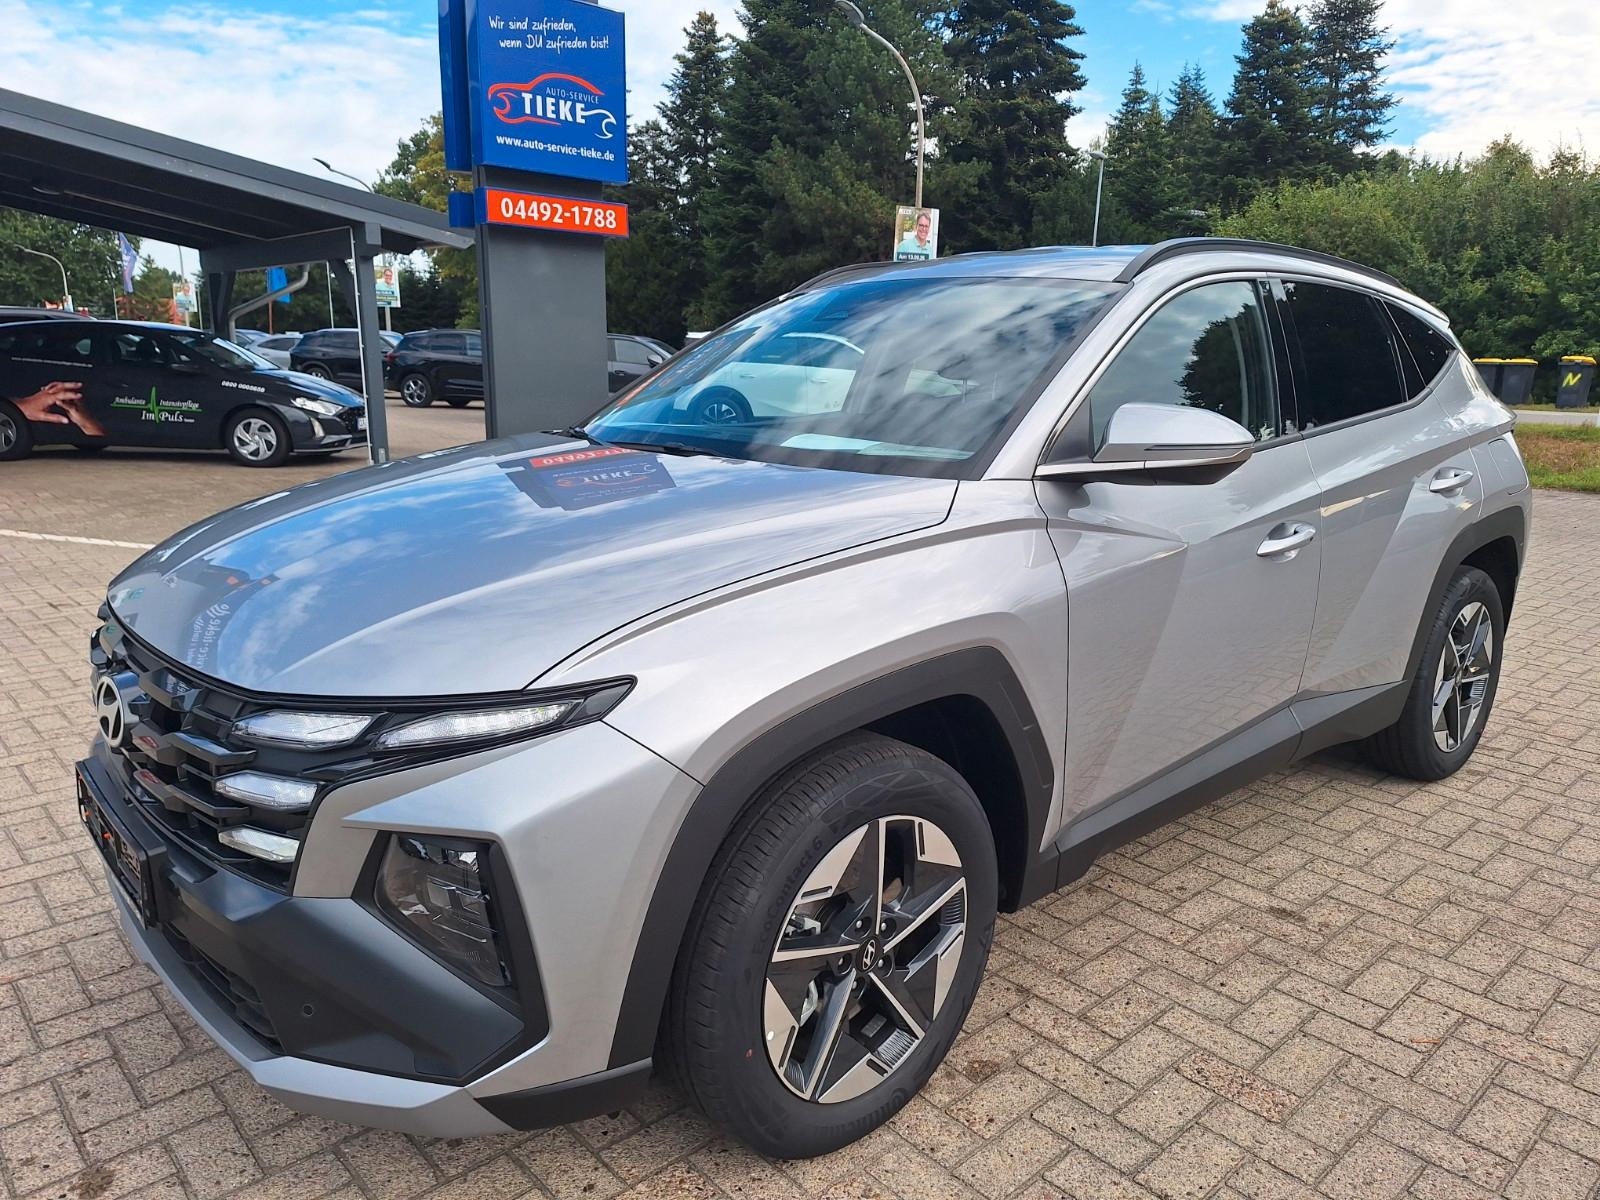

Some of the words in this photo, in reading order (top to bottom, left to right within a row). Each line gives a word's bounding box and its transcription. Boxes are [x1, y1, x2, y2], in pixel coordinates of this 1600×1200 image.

[488, 16, 505, 30] Wir
[508, 17, 528, 31] sind
[532, 19, 576, 36] zufrieden,
[499, 39, 522, 49] wenn
[526, 34, 543, 49] DU
[545, 36, 587, 54] zufrieden
[590, 35, 609, 49] bist!
[546, 87, 600, 104] AUTO-SERVICE
[521, 92, 586, 124] TIEKE
[496, 135, 615, 161] www.auto-service-tieke.de
[501, 197, 617, 229] 04492-1788
[159, 411, 184, 422] Puls
